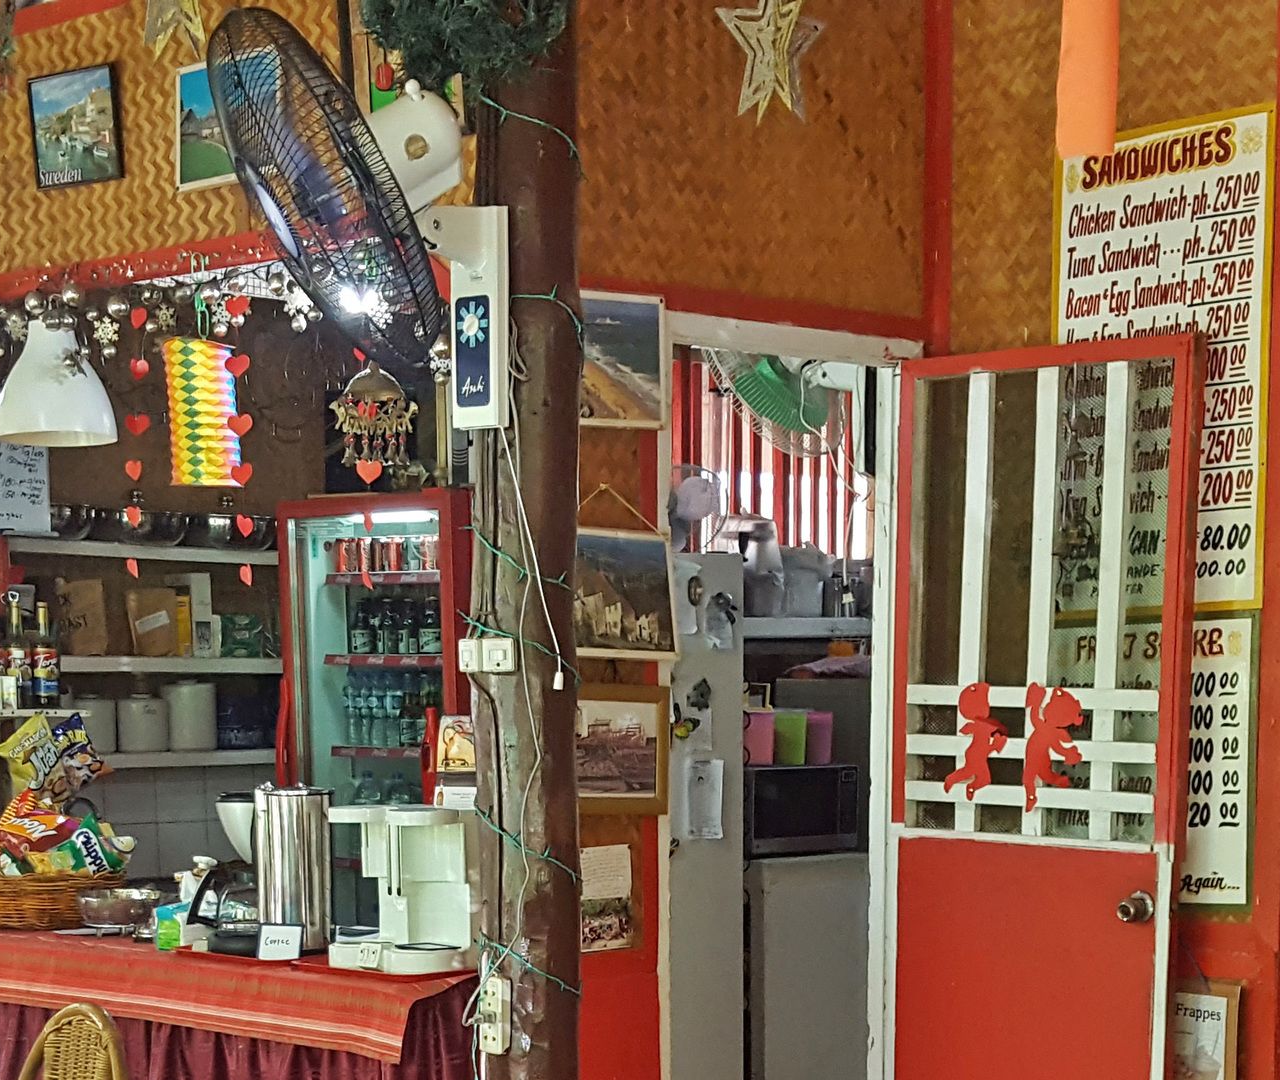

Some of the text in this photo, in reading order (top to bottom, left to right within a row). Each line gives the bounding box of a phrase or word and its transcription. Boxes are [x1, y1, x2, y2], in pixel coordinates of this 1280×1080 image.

[39, 165, 82, 187] Sweden
[1081, 125, 1233, 190] SANDWICHES
[1068, 202, 1116, 239] Chicken
[1067, 245, 1096, 280] Tuna
[1098, 231, 1161, 275] Sandwich
[1065, 287, 1101, 320] Bacon
[1108, 280, 1131, 317] Egg
[75, 830, 108, 877] Chippy
[1175, 1003, 1222, 1022] Frappes
